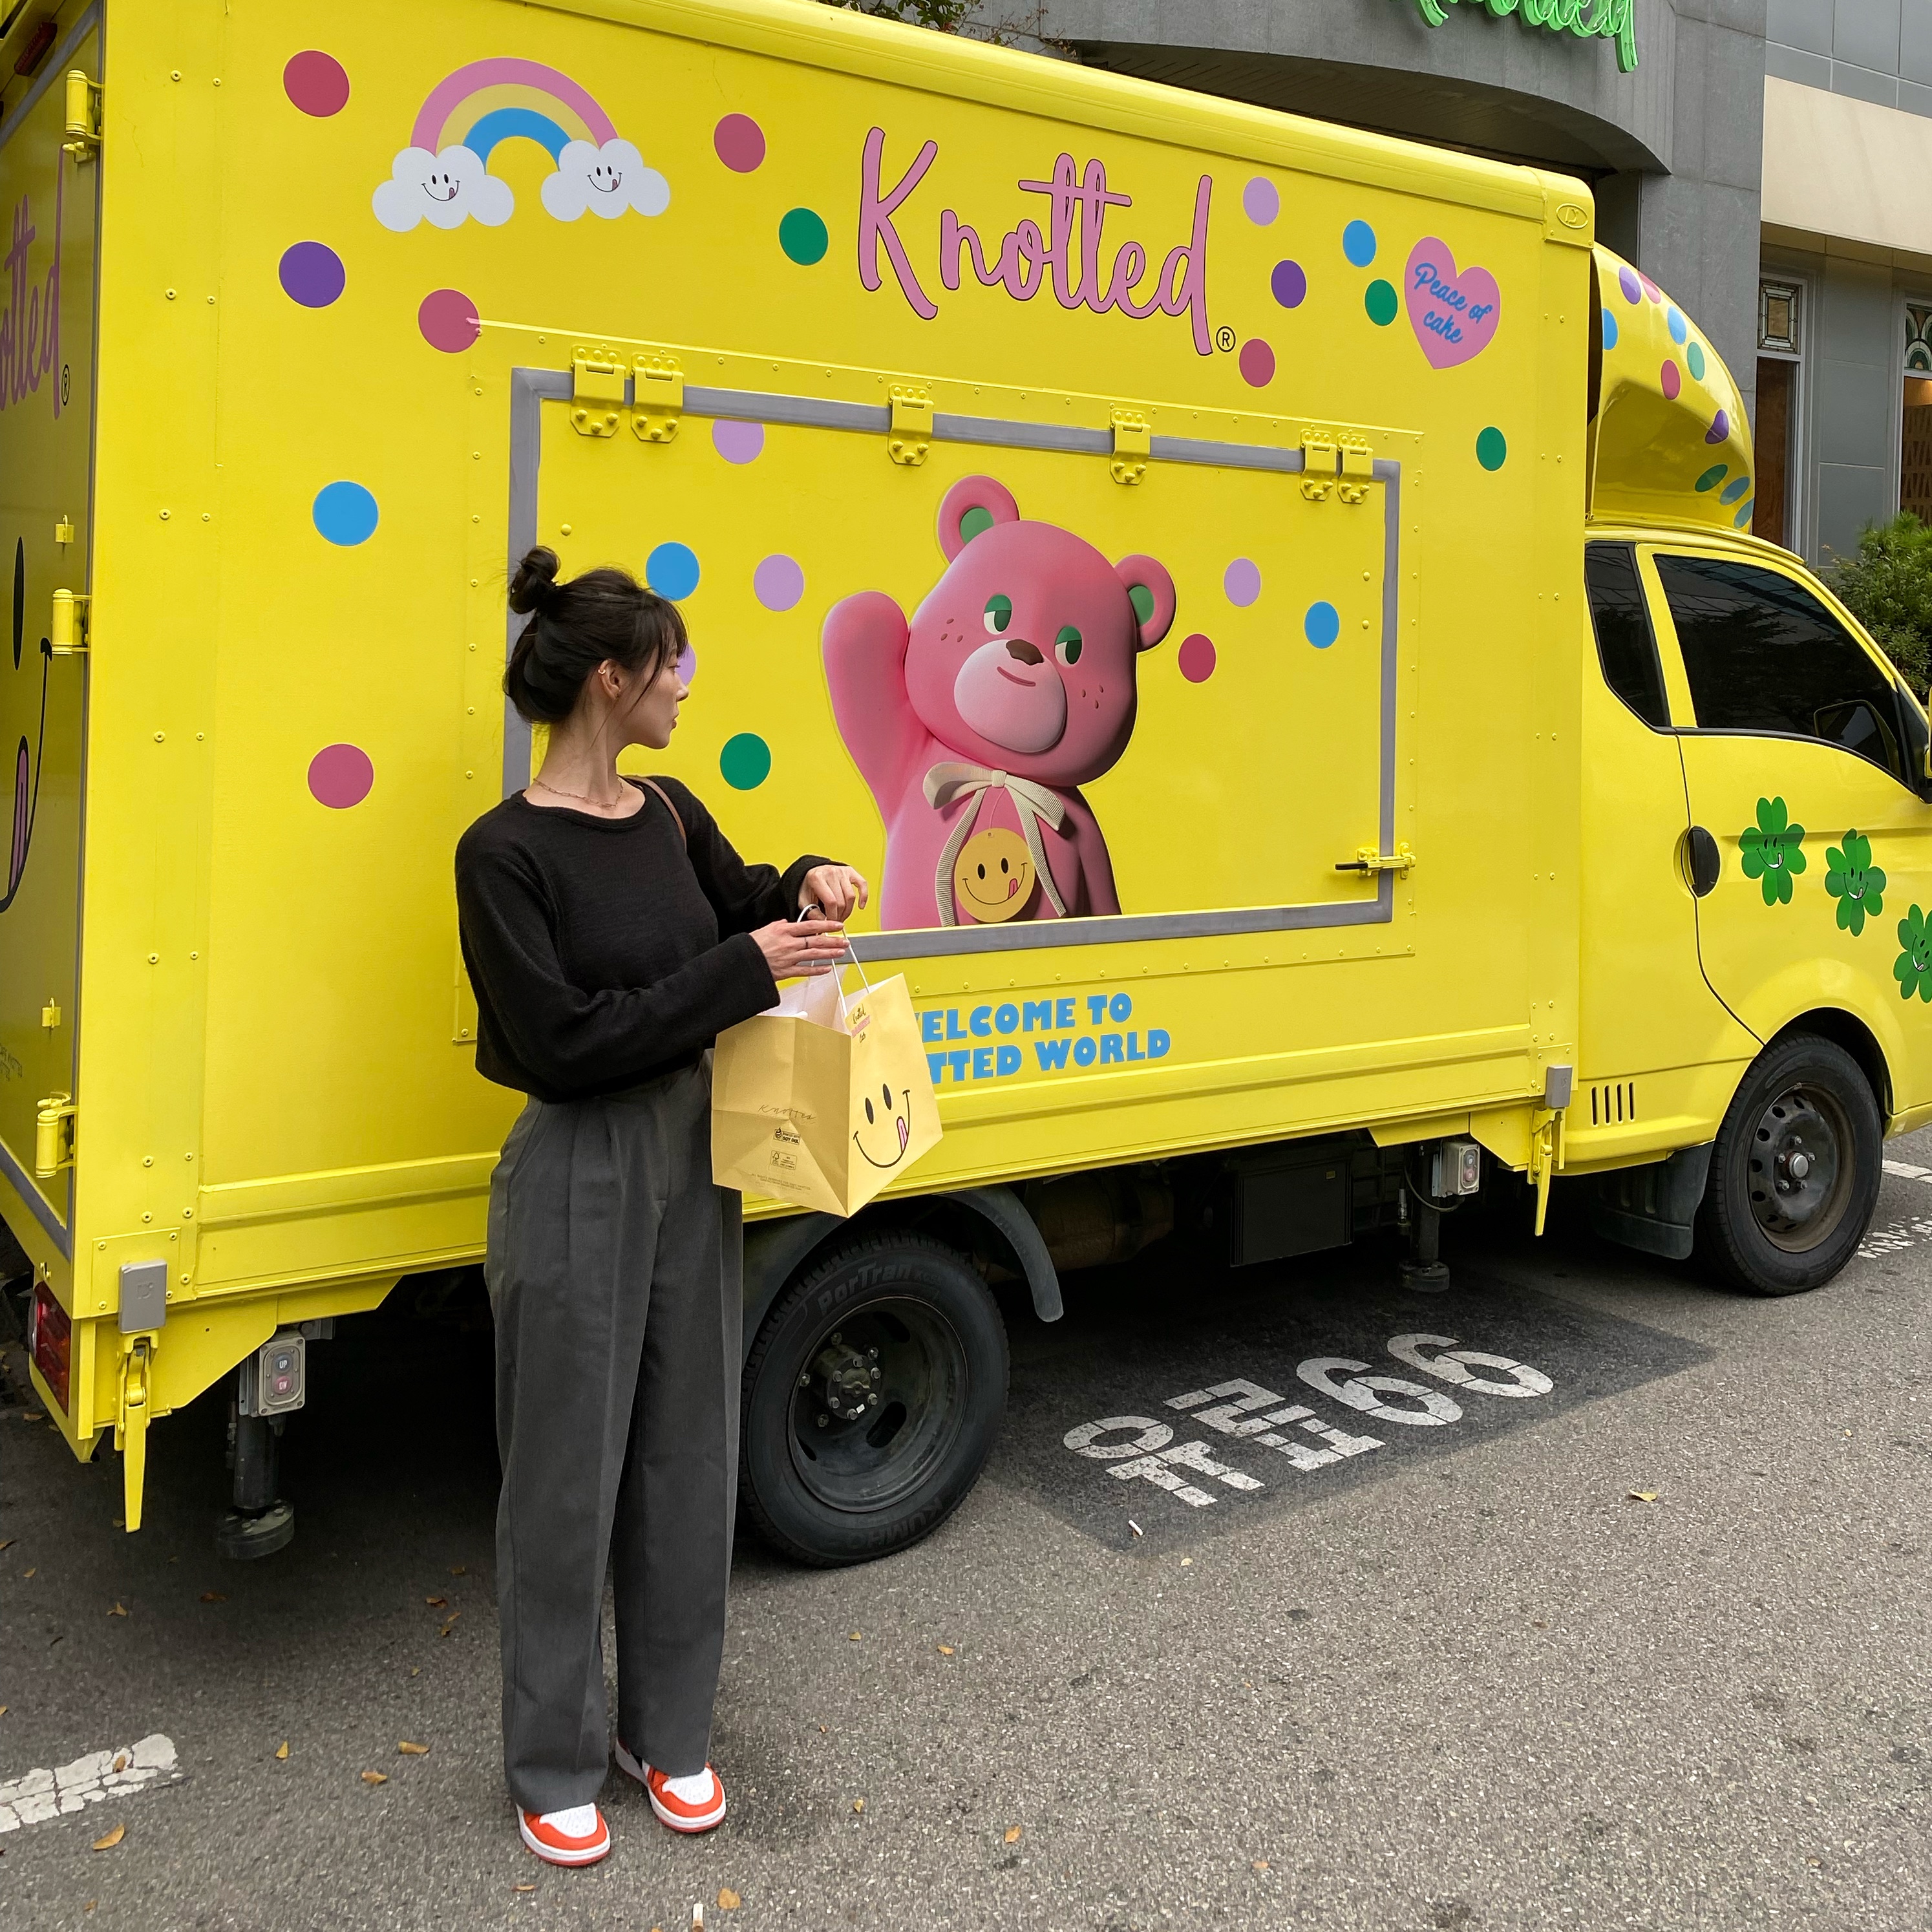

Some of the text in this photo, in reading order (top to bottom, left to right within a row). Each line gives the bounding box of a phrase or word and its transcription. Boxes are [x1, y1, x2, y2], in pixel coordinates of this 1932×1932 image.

[858, 126, 1213, 356] Knotted
[1414, 262, 1493, 324] Peace of
[1423, 310, 1463, 344] cake
[915, 997, 1076, 1043] ELCOME
[1087, 992, 1132, 1025] TO
[1034, 1028, 1171, 1072] WORLD
[279, 1359, 288, 1369] UP
